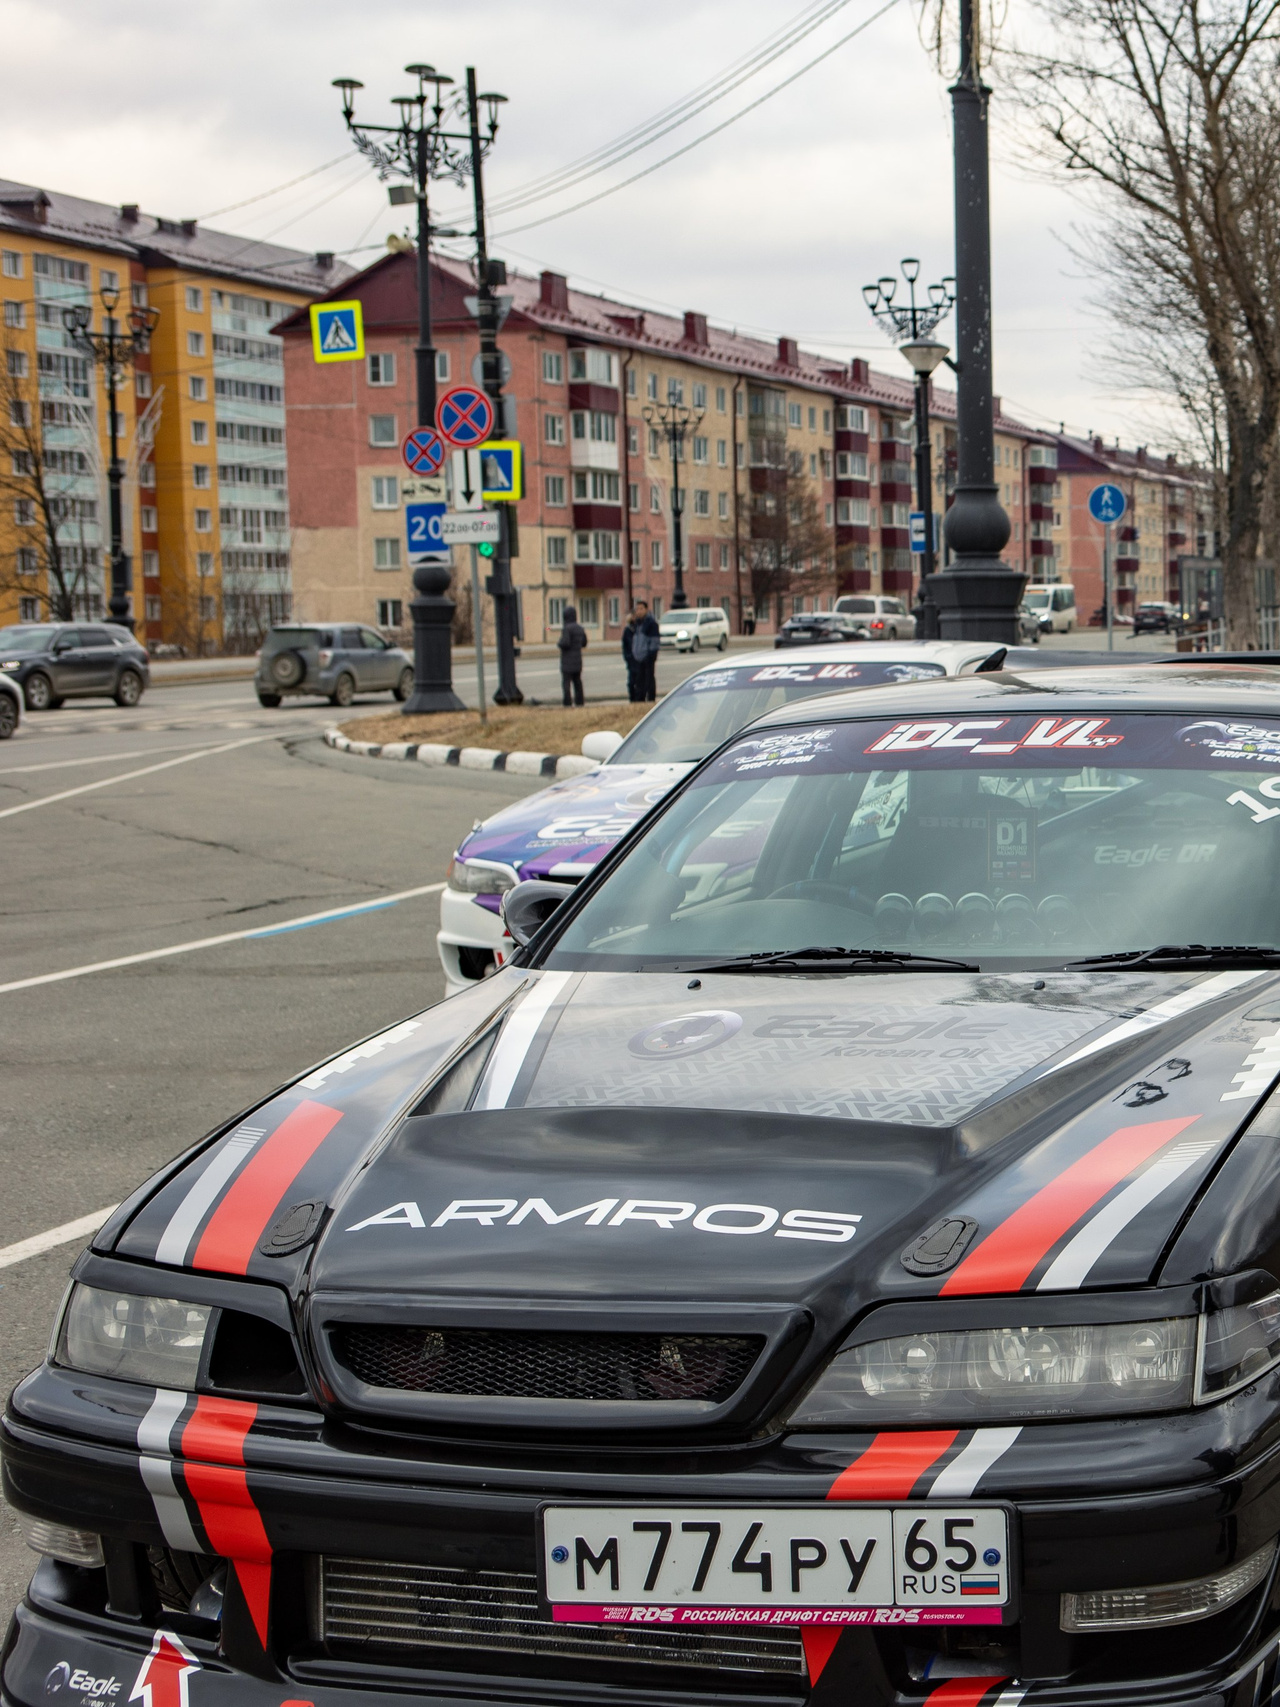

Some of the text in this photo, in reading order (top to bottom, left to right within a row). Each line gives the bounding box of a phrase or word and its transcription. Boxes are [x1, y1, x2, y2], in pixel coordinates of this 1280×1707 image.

[411, 515, 442, 541] 20
[1211, 749, 1257, 760] DRIFT
[996, 821, 1027, 846] D1
[1094, 844, 1172, 867] Eagle
[752, 1015, 1008, 1045] Eagle
[821, 1046, 928, 1058] Korean
[345, 1198, 863, 1243] ARMROS
[904, 1518, 977, 1573] 65
[903, 1575, 956, 1595] RUS
[629, 1607, 678, 1622] RDS
[681, 1608, 868, 1623] РОССИЙСКАЯ ДРИФТ СЕРИЯ
[873, 1608, 923, 1623] RDS
[69, 1668, 123, 1697] Eagle
